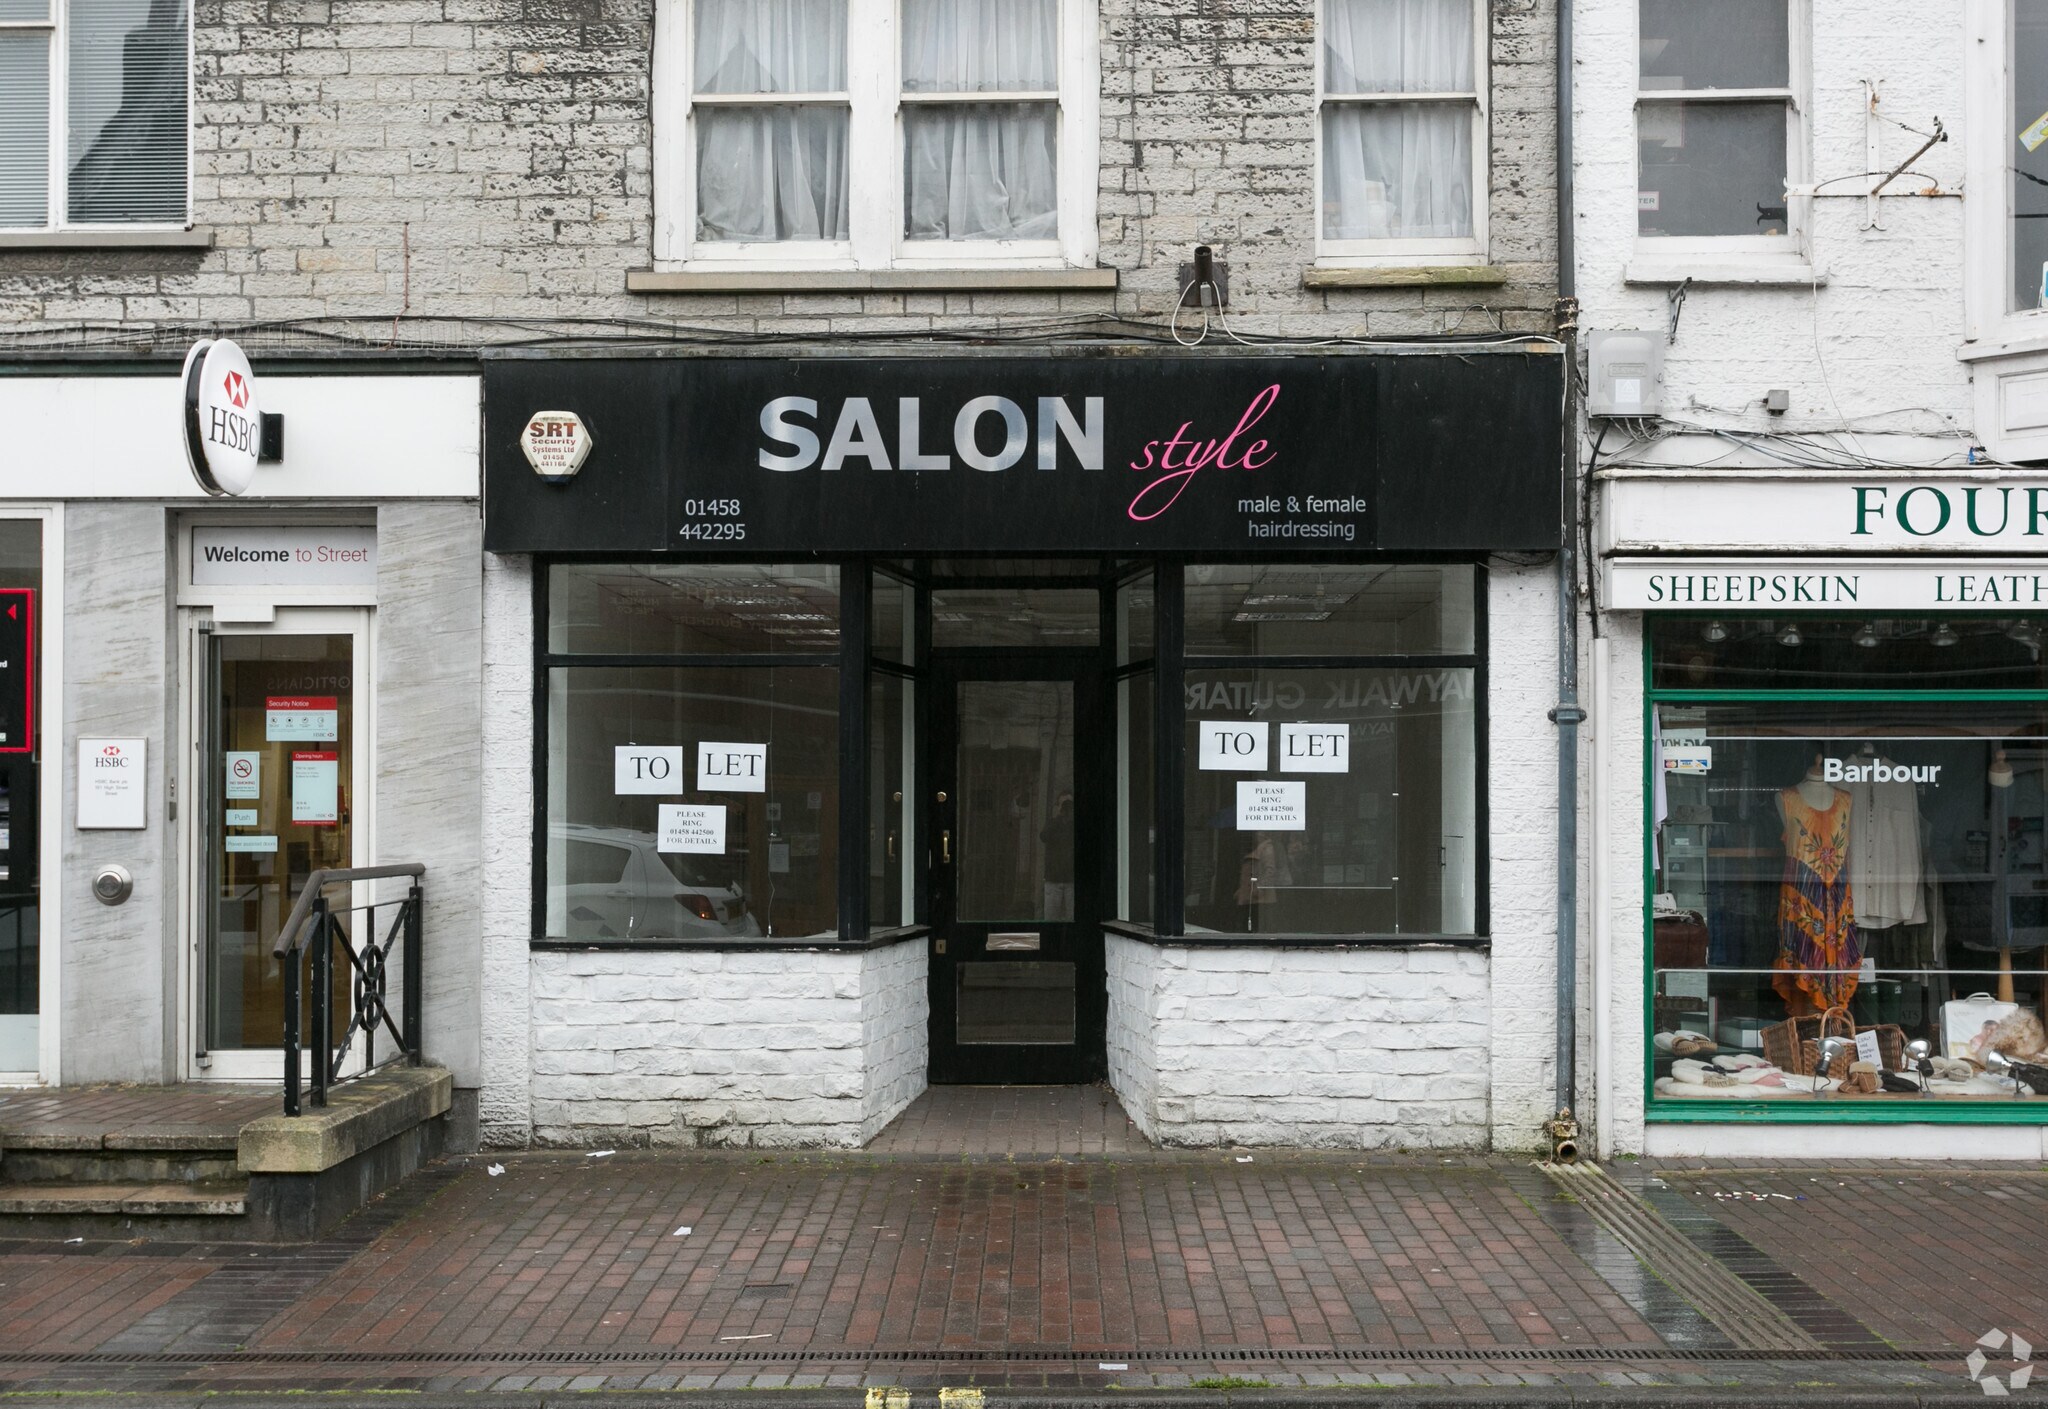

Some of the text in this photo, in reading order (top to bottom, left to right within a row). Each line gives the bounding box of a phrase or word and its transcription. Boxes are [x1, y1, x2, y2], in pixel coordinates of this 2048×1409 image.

[208, 406, 258, 458] HSBC
[529, 422, 577, 437] SRT
[758, 395, 1105, 472] SALON
[531, 438, 576, 446] Security
[532, 446, 562, 454] Systems
[1128, 383, 1281, 521] style
[685, 499, 740, 516] 01458
[1237, 496, 1366, 513] male & female
[1850, 486, 2048, 537] FOUR
[679, 523, 746, 540] 442295
[1248, 520, 1355, 541] hairdressing
[204, 545, 368, 563] Welcome to Street
[1647, 574, 2048, 603] SHEEPSKIN LEATH
[268, 700, 291, 708] Security
[1214, 732, 1345, 757] TO LET
[95, 757, 129, 768] HSBC
[629, 752, 762, 780] TO LET
[1823, 757, 1942, 784] Barbour
[1255, 787, 1286, 795] PLEASE
[1260, 796, 1282, 804] RING
[234, 813, 251, 821] Push
[676, 810, 707, 818] PLEASE
[1248, 805, 1294, 813] 01458 442500
[682, 819, 703, 827] RING
[669, 828, 714, 836] 01458 442500
[666, 836, 718, 845] FOR DETAILS
